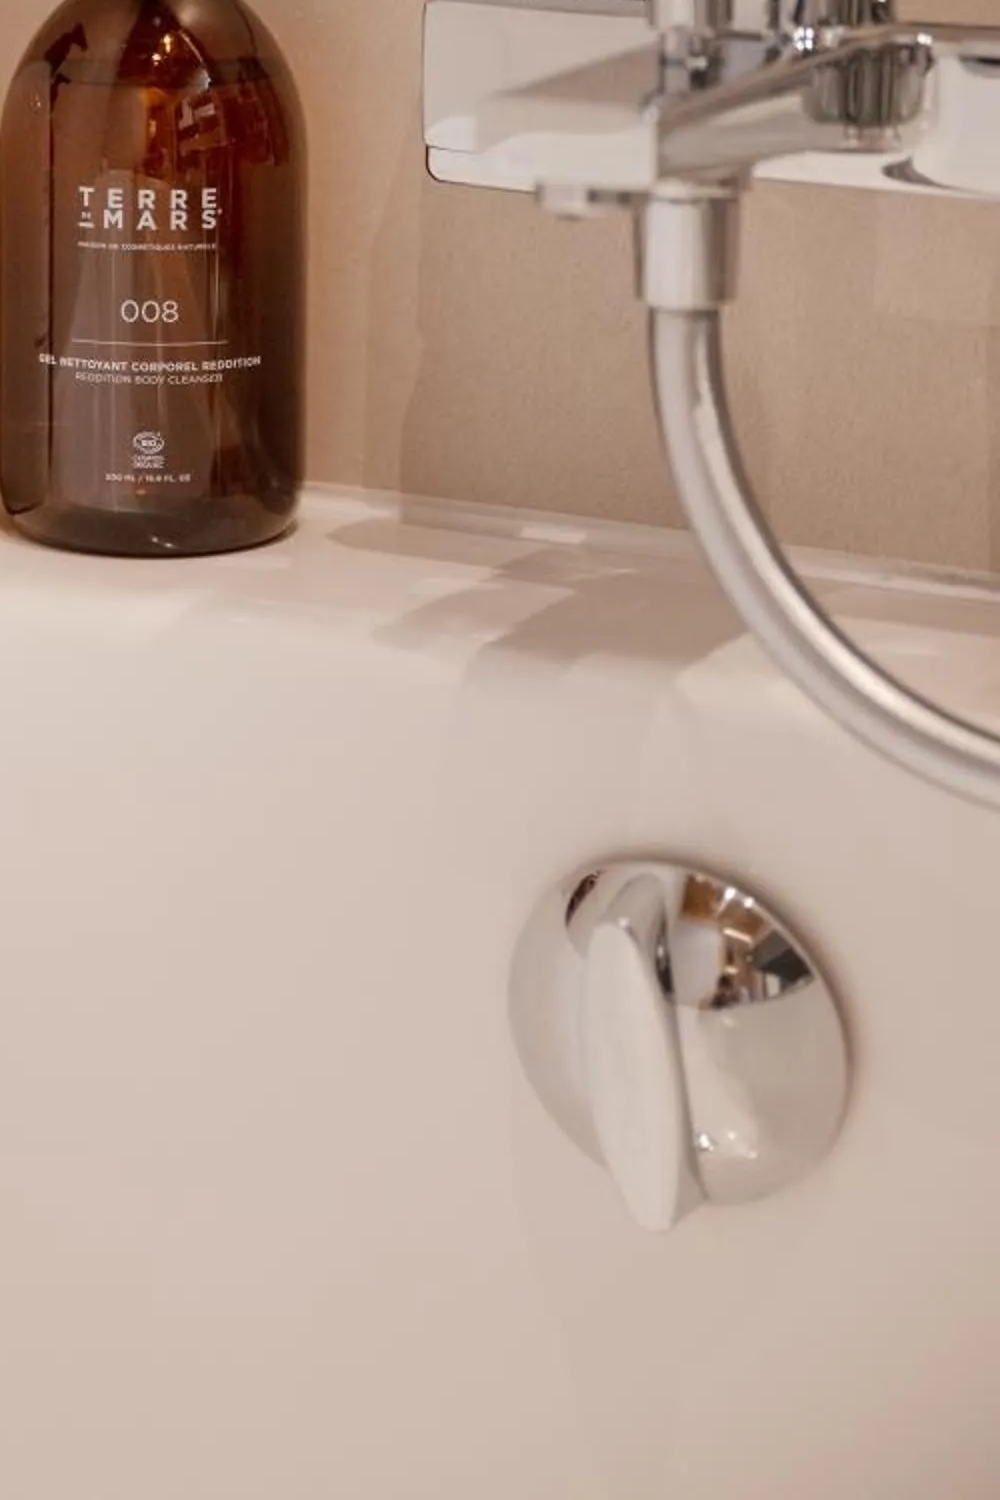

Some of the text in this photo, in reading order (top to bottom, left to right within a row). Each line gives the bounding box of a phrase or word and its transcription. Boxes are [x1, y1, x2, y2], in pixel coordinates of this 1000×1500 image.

[79, 186, 217, 209] TERRE
[103, 208, 217, 230] MARS
[120, 299, 179, 323] 008
[39, 353, 261, 373] GEL NETTOYANT CORPOREL REDDITION
[135, 374, 165, 385] BODY
